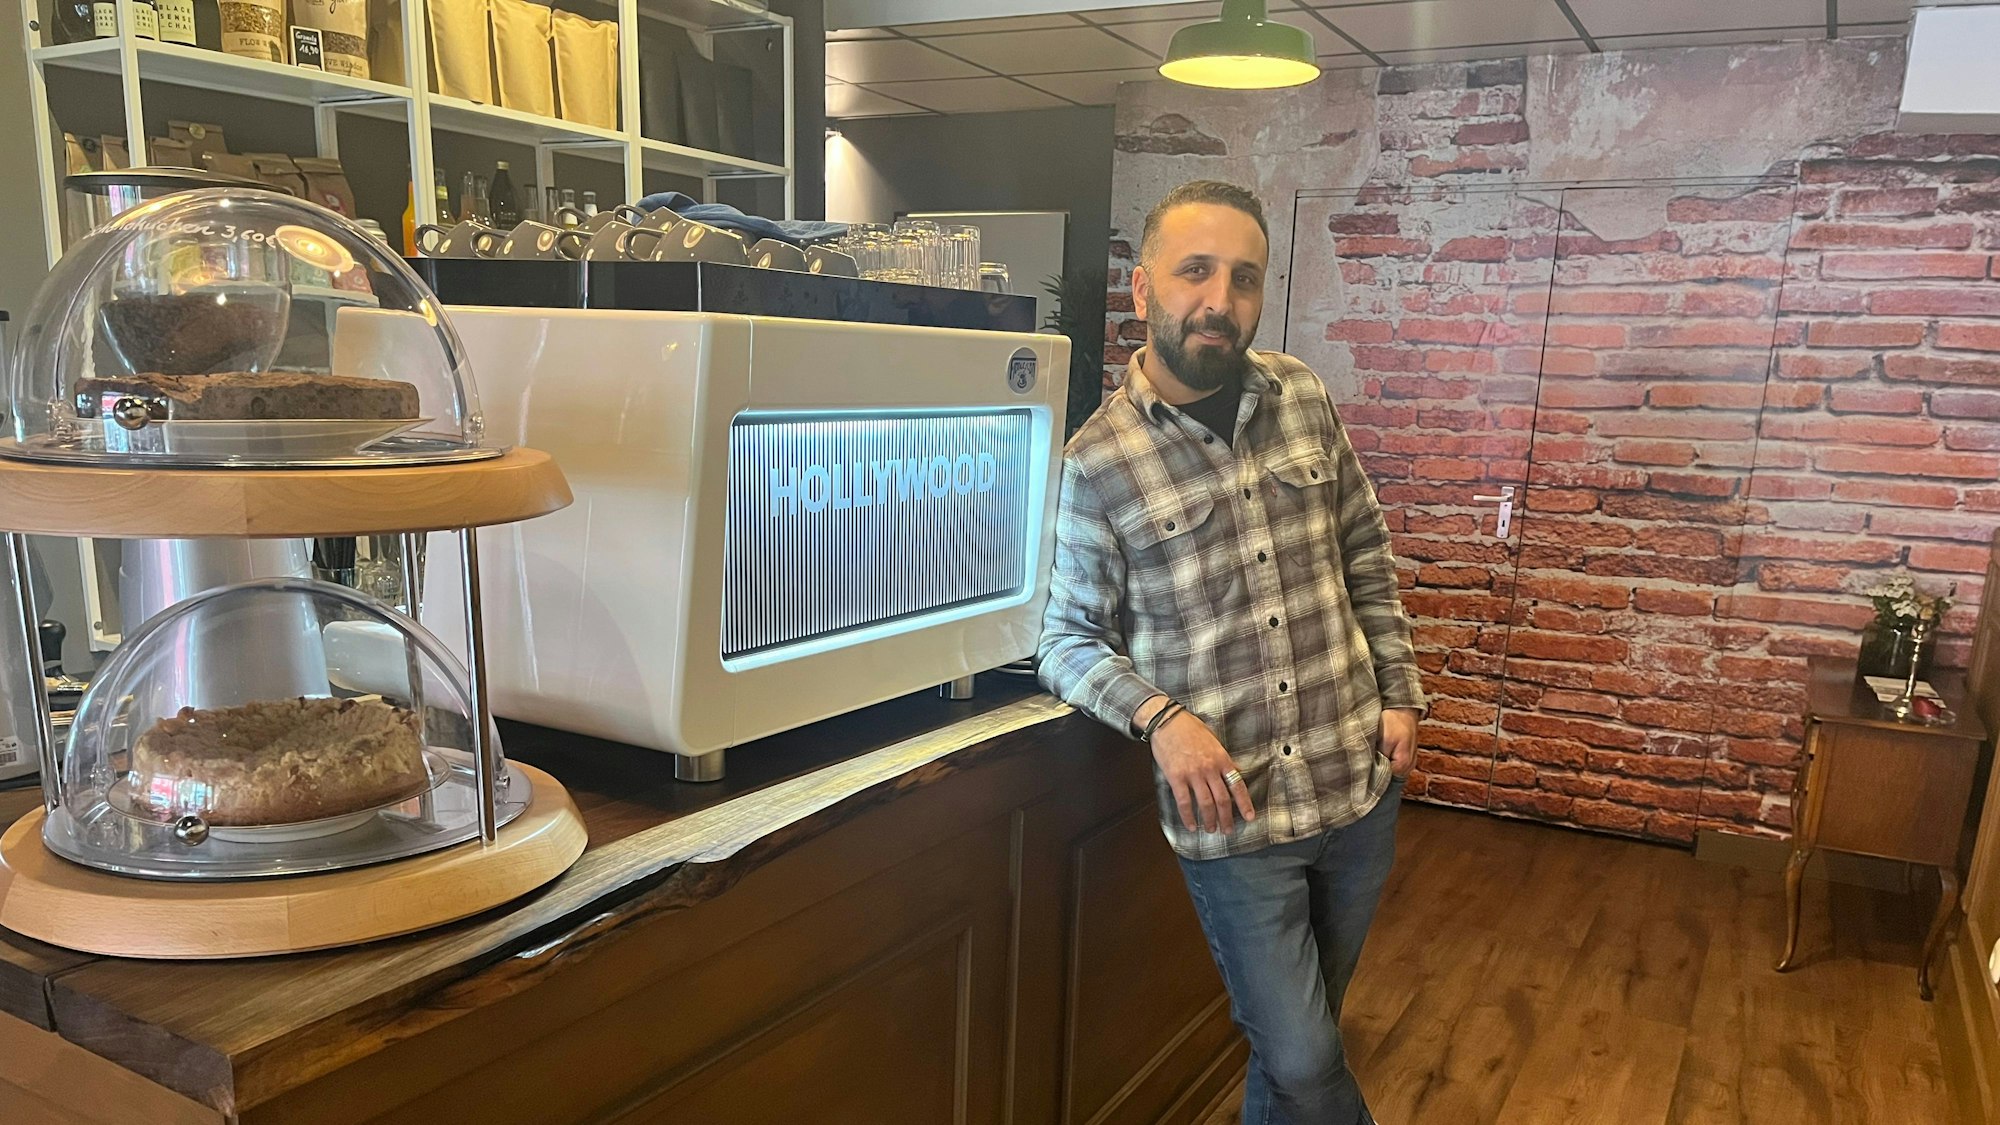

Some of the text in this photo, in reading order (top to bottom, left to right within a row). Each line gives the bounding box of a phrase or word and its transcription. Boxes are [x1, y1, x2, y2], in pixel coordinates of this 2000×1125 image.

[158, 4, 191, 14] BLACK
[159, 13, 192, 23] SENSE
[769, 452, 996, 518] HOLLYWOOD
